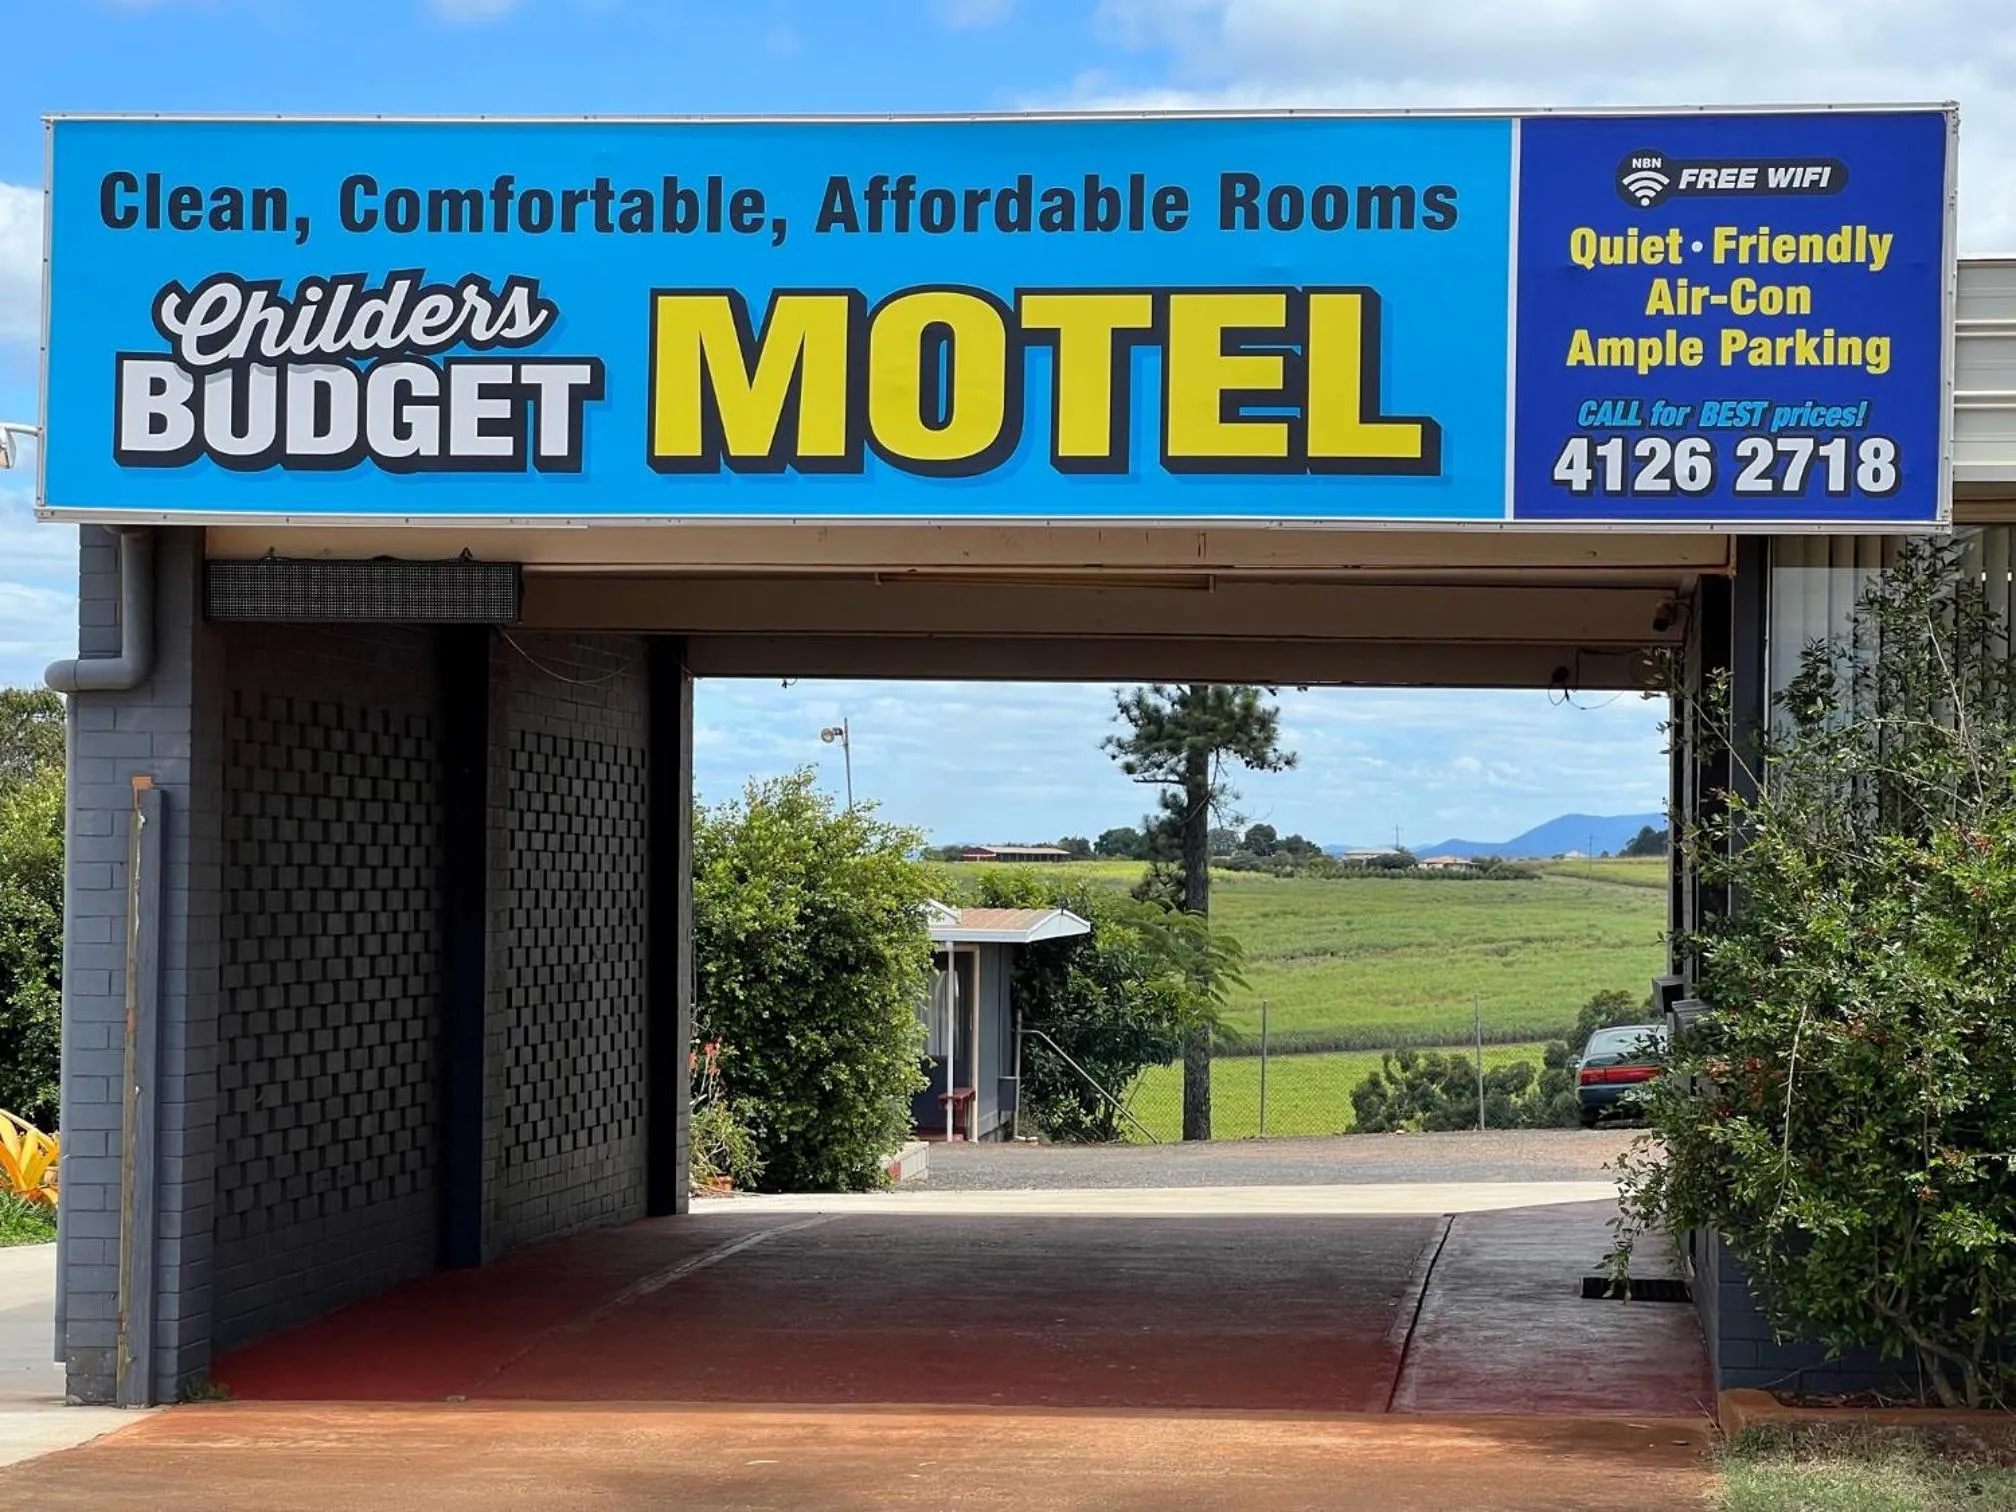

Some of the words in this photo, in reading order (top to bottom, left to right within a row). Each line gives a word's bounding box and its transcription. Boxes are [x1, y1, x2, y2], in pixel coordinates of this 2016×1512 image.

[1631, 156, 1662, 169] NBN
[1678, 167, 1757, 189] FREE
[1766, 165, 1832, 188] WIFI
[100, 170, 312, 246] Clean,
[339, 172, 788, 247] Comfortable,
[815, 172, 1190, 234] Affordable
[1218, 171, 1460, 232] Rooms
[1568, 226, 1683, 270] Quiet
[1713, 225, 1894, 272] Friendly
[1644, 277, 1812, 316] Air-Con
[160, 279, 548, 366] Childers
[1565, 328, 1705, 375] Ample
[1720, 327, 1892, 375] Parking
[654, 292, 1423, 460] MOTEL
[120, 360, 592, 458] BUDGET
[1577, 399, 1642, 427] CALL
[1651, 400, 1690, 427] for
[1698, 401, 1767, 427] BEST
[1770, 400, 1869, 433] prices!
[1553, 437, 1713, 493] 4126
[1734, 436, 1898, 493] 2718
